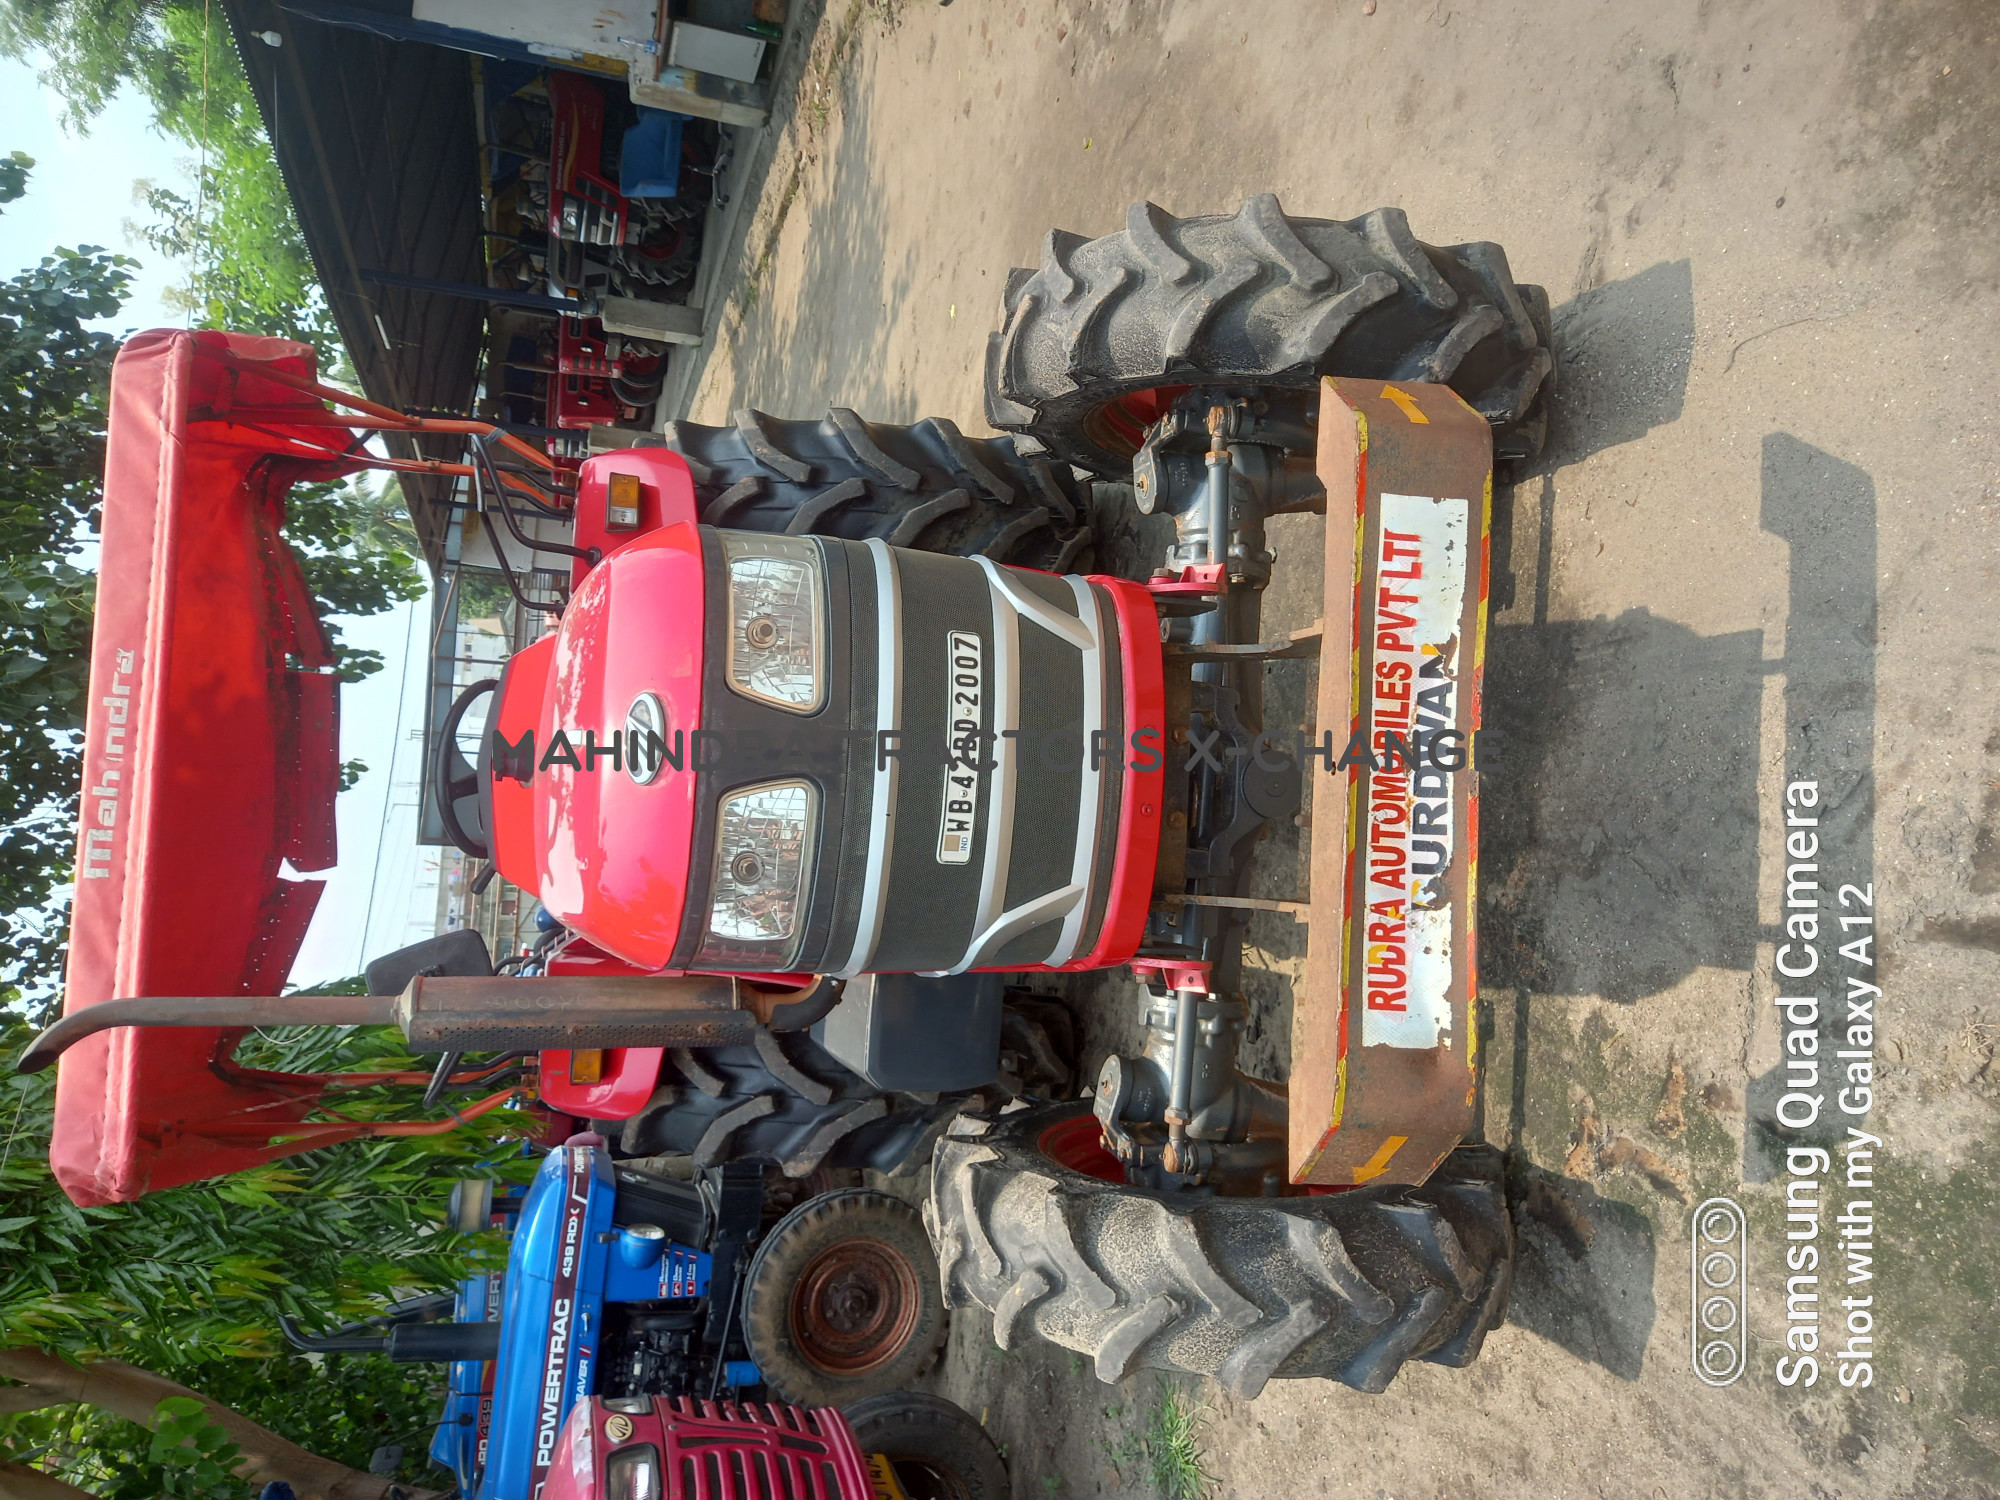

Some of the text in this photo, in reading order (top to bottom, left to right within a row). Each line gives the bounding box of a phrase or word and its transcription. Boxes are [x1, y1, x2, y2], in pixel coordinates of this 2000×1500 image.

[1376, 587, 1419, 653] PVT
[946, 636, 979, 832] WB 42BD 2007
[1370, 661, 1413, 891] AUTOMOBILES
[960, 836, 969, 852] IND
[1367, 898, 1407, 1013] RUDRA
[561, 1207, 580, 1278] 439 RDX
[479, 1398, 493, 1437] 439
[535, 1298, 571, 1466] POWERTRAC
